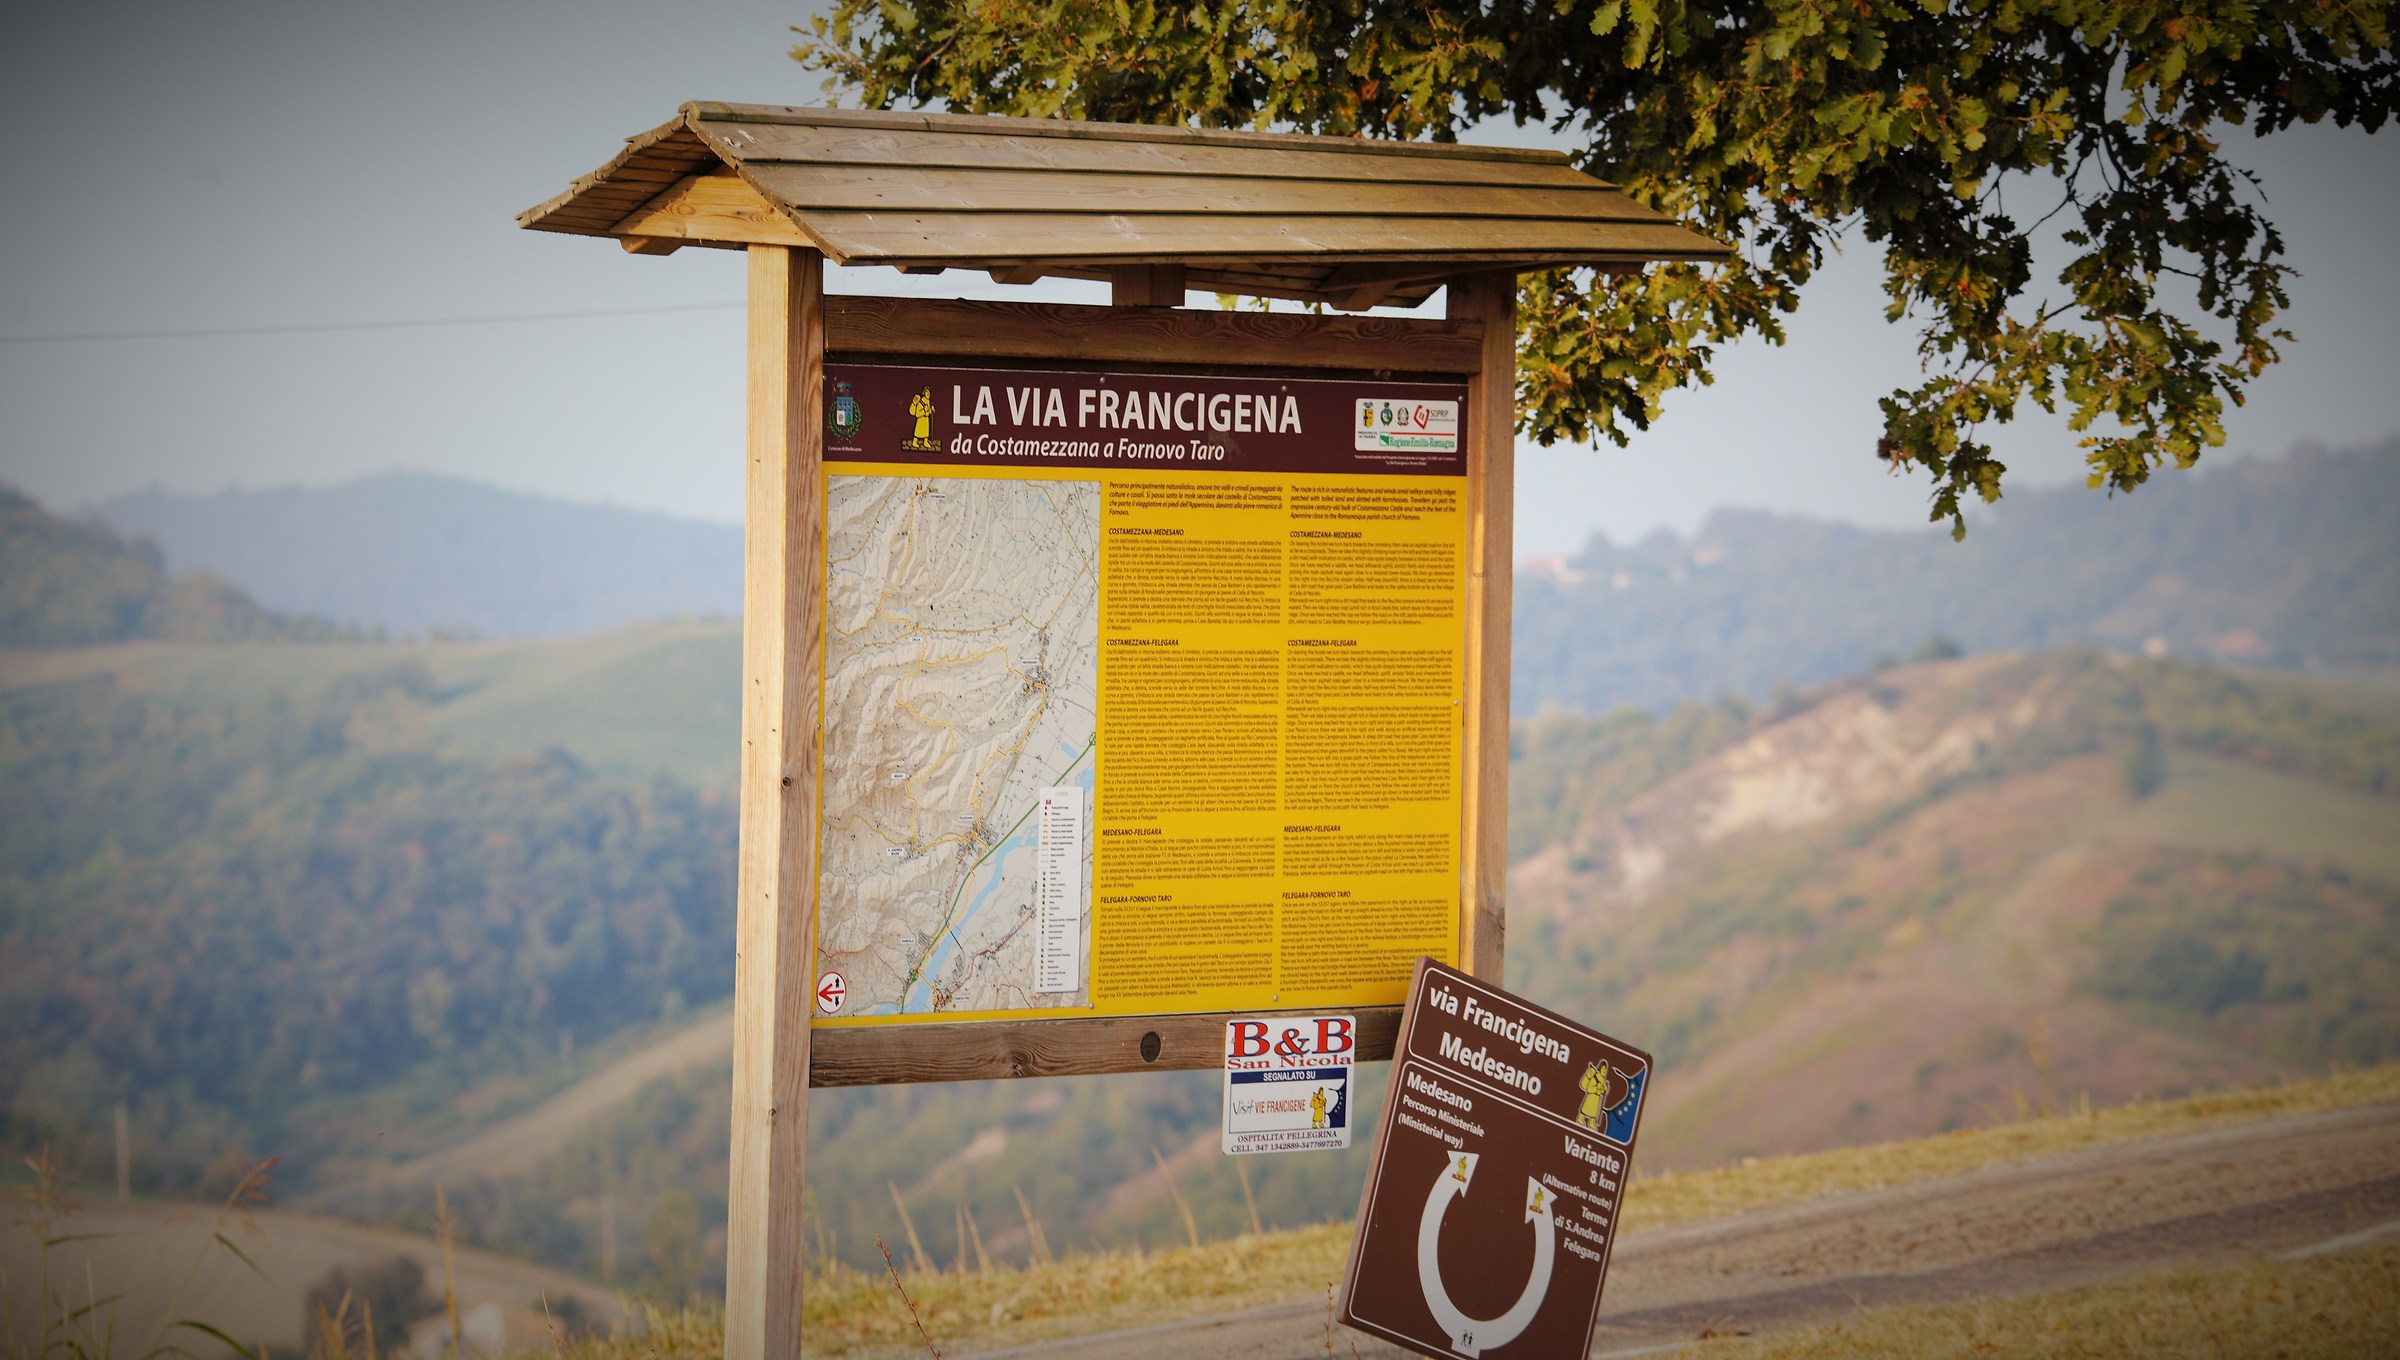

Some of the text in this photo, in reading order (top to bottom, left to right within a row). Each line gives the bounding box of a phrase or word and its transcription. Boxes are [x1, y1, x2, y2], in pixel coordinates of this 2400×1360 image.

[953, 385, 1302, 434] LA VIA FRANCIGENA
[951, 433, 1224, 461] da Costamezzana a Fornovo Taro
[1108, 527, 1184, 536] COSTAMEZZANA-MEDESANO
[1100, 894, 1156, 903] FELEGARA-FORNOVO
[1282, 890, 1336, 899] FELEGARA-FORNOVO
[1228, 1018, 1353, 1058] B&B
[1430, 986, 1570, 1064] via Francigena
[1228, 1054, 1352, 1070] San Nicola
[1439, 1032, 1541, 1095] Medesano
[1263, 1071, 1316, 1082] SEGNALATO SU
[1407, 1071, 1472, 1112] Medesano
[1232, 1099, 1306, 1115] Visit VIE FRANCIGENE
[1403, 1094, 1484, 1137] Percorso Ministeriale
[1287, 1130, 1338, 1140] PELLEGRINA
[1398, 1113, 1464, 1149] (Ministerial way)
[1565, 1135, 1620, 1174] Variante
[1542, 1173, 1612, 1211] (Alternative route)
[1590, 1170, 1616, 1192] 8 km
[1554, 1215, 1604, 1245] di S.Andrea
[1582, 1206, 1608, 1227] Terme
[1564, 1238, 1600, 1262] Felegara
